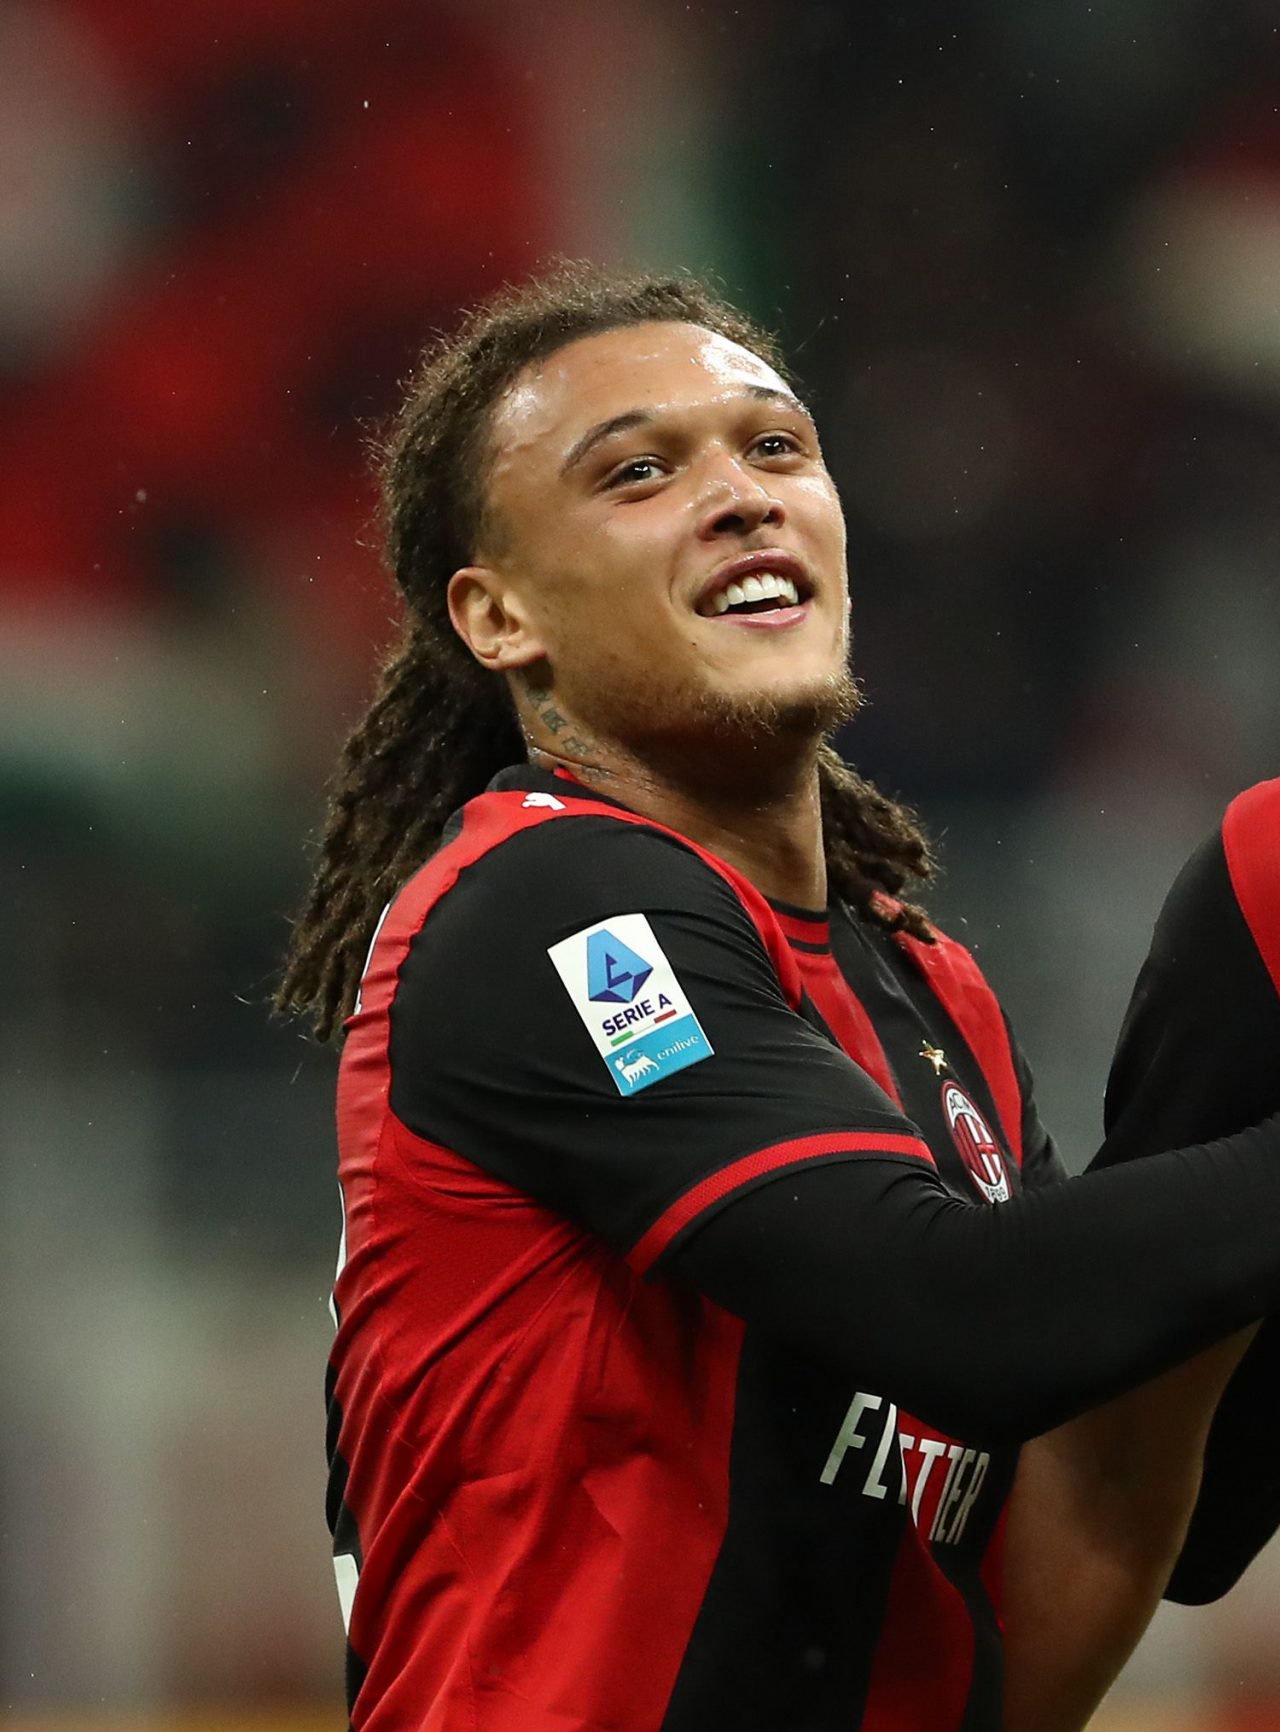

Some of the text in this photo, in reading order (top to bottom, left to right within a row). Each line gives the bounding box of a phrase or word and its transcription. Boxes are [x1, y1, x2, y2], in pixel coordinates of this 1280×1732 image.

[602, 993, 673, 1036] SERIE A
[656, 1033, 700, 1061] enilive
